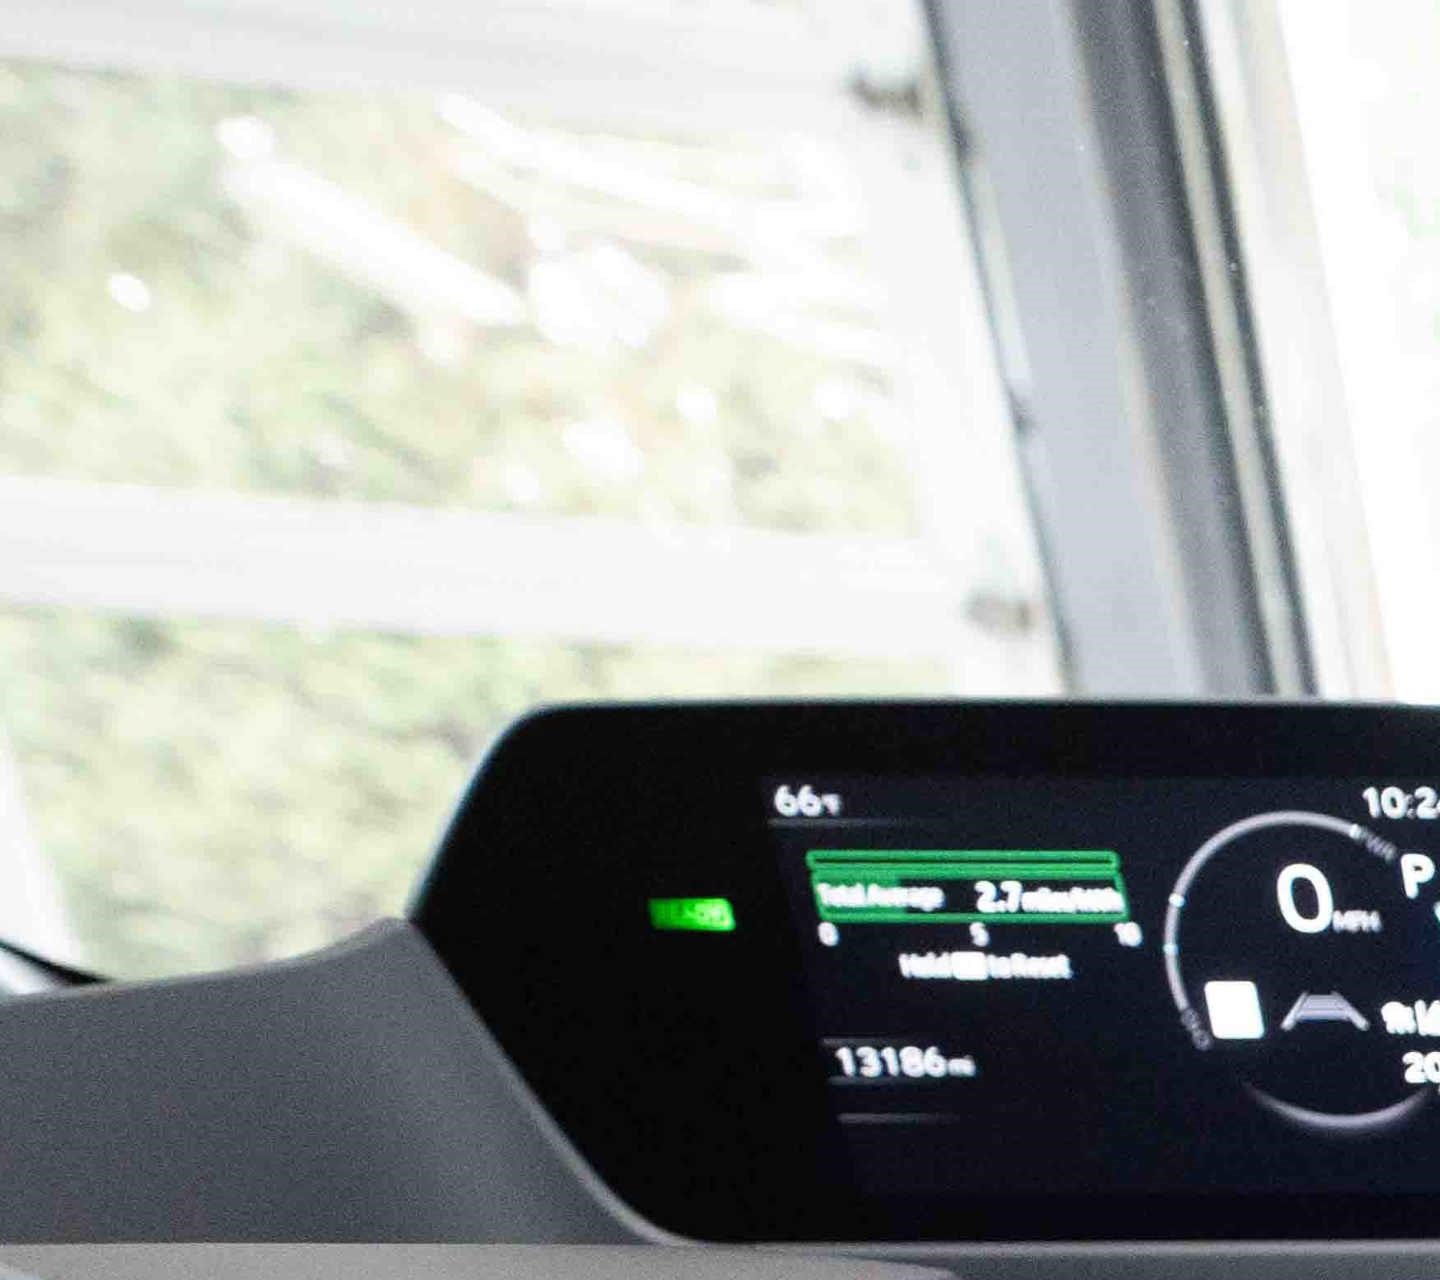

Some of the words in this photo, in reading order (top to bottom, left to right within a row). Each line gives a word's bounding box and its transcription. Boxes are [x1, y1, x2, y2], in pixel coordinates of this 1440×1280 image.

[1400, 853, 1435, 899] P
[975, 881, 1021, 912] 2.7
[1277, 864, 1332, 933] 0
[818, 922, 841, 946] 0
[836, 1046, 948, 1077] 13186
